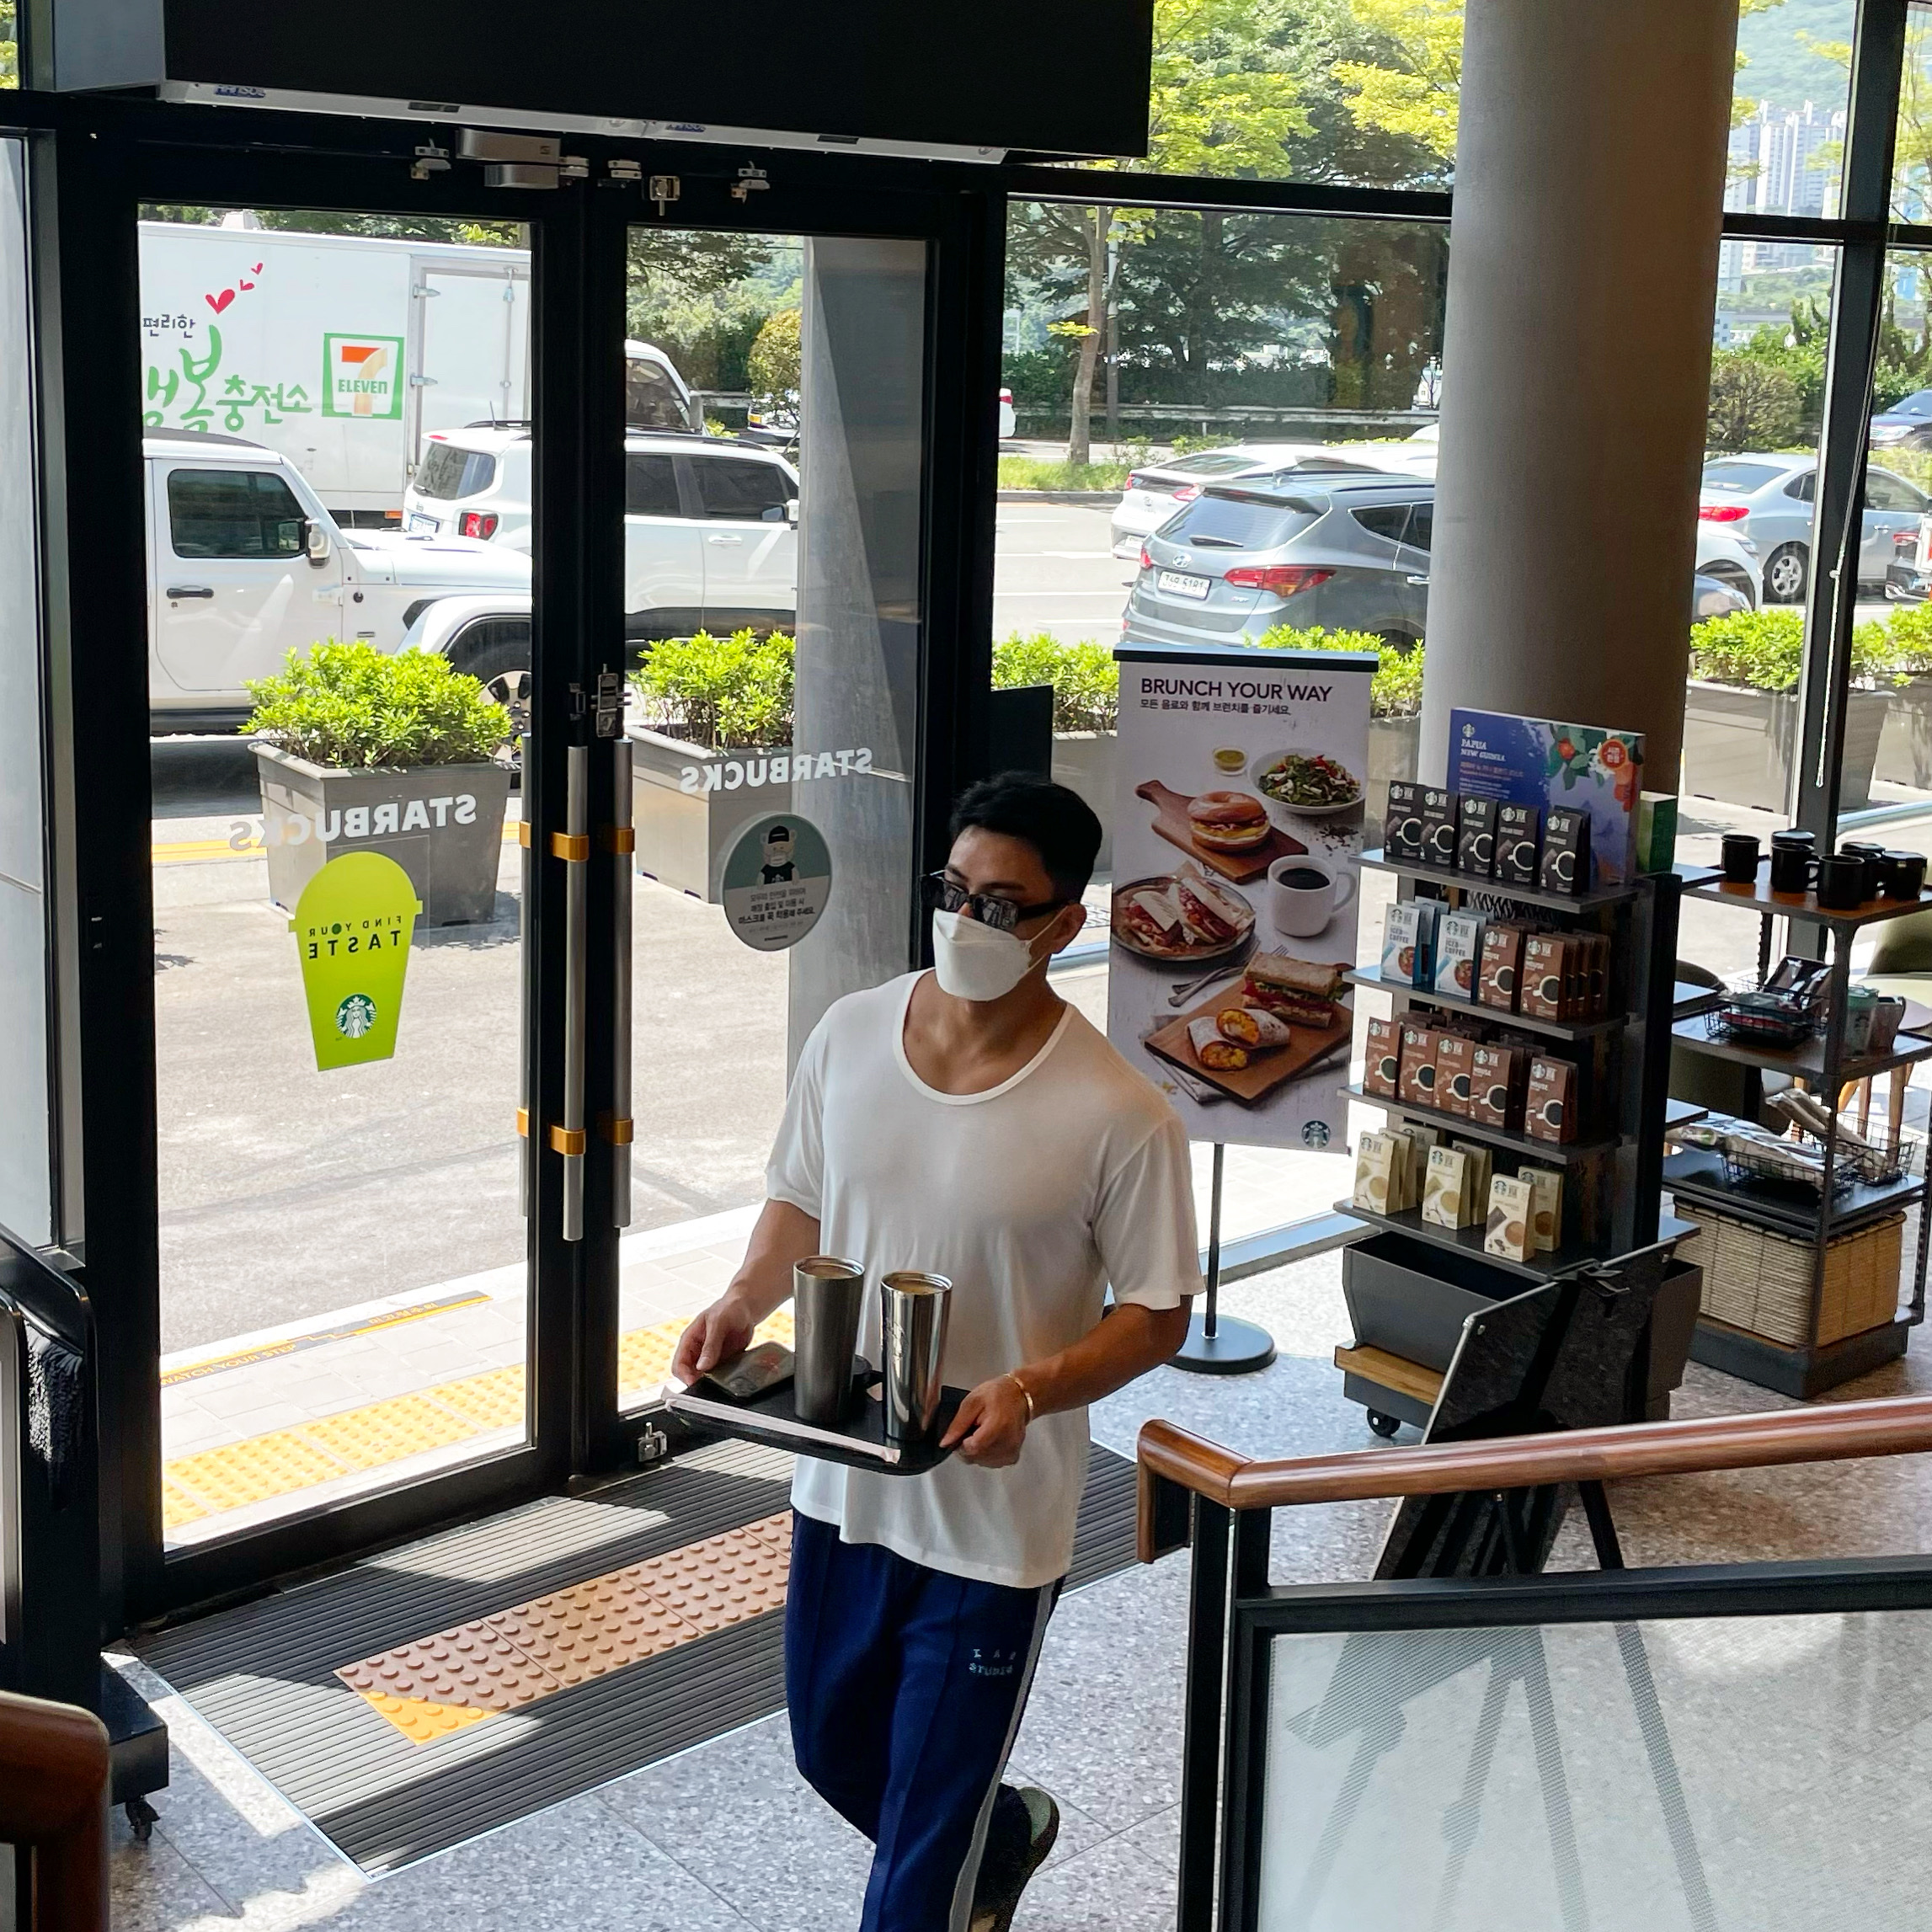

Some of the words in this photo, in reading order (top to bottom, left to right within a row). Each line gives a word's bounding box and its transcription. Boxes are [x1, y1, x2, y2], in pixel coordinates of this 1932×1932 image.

[143, 313, 195, 339] 편리한
[1141, 678, 1221, 696] BRUNCH
[1227, 682, 1283, 700] YOUR
[1287, 684, 1333, 702] WAY
[1140, 699, 1159, 709] 모든
[1161, 699, 1188, 711] 음료와
[1192, 701, 1210, 712] 함께
[1213, 702, 1249, 713] 브런치를
[1461, 739, 1487, 750] PAPUA
[1389, 934, 1409, 943] COFFEE
[1444, 946, 1466, 957] COFFEE
[214, 1354, 260, 1369] YOUR
[262, 1343, 296, 1358] STEP
